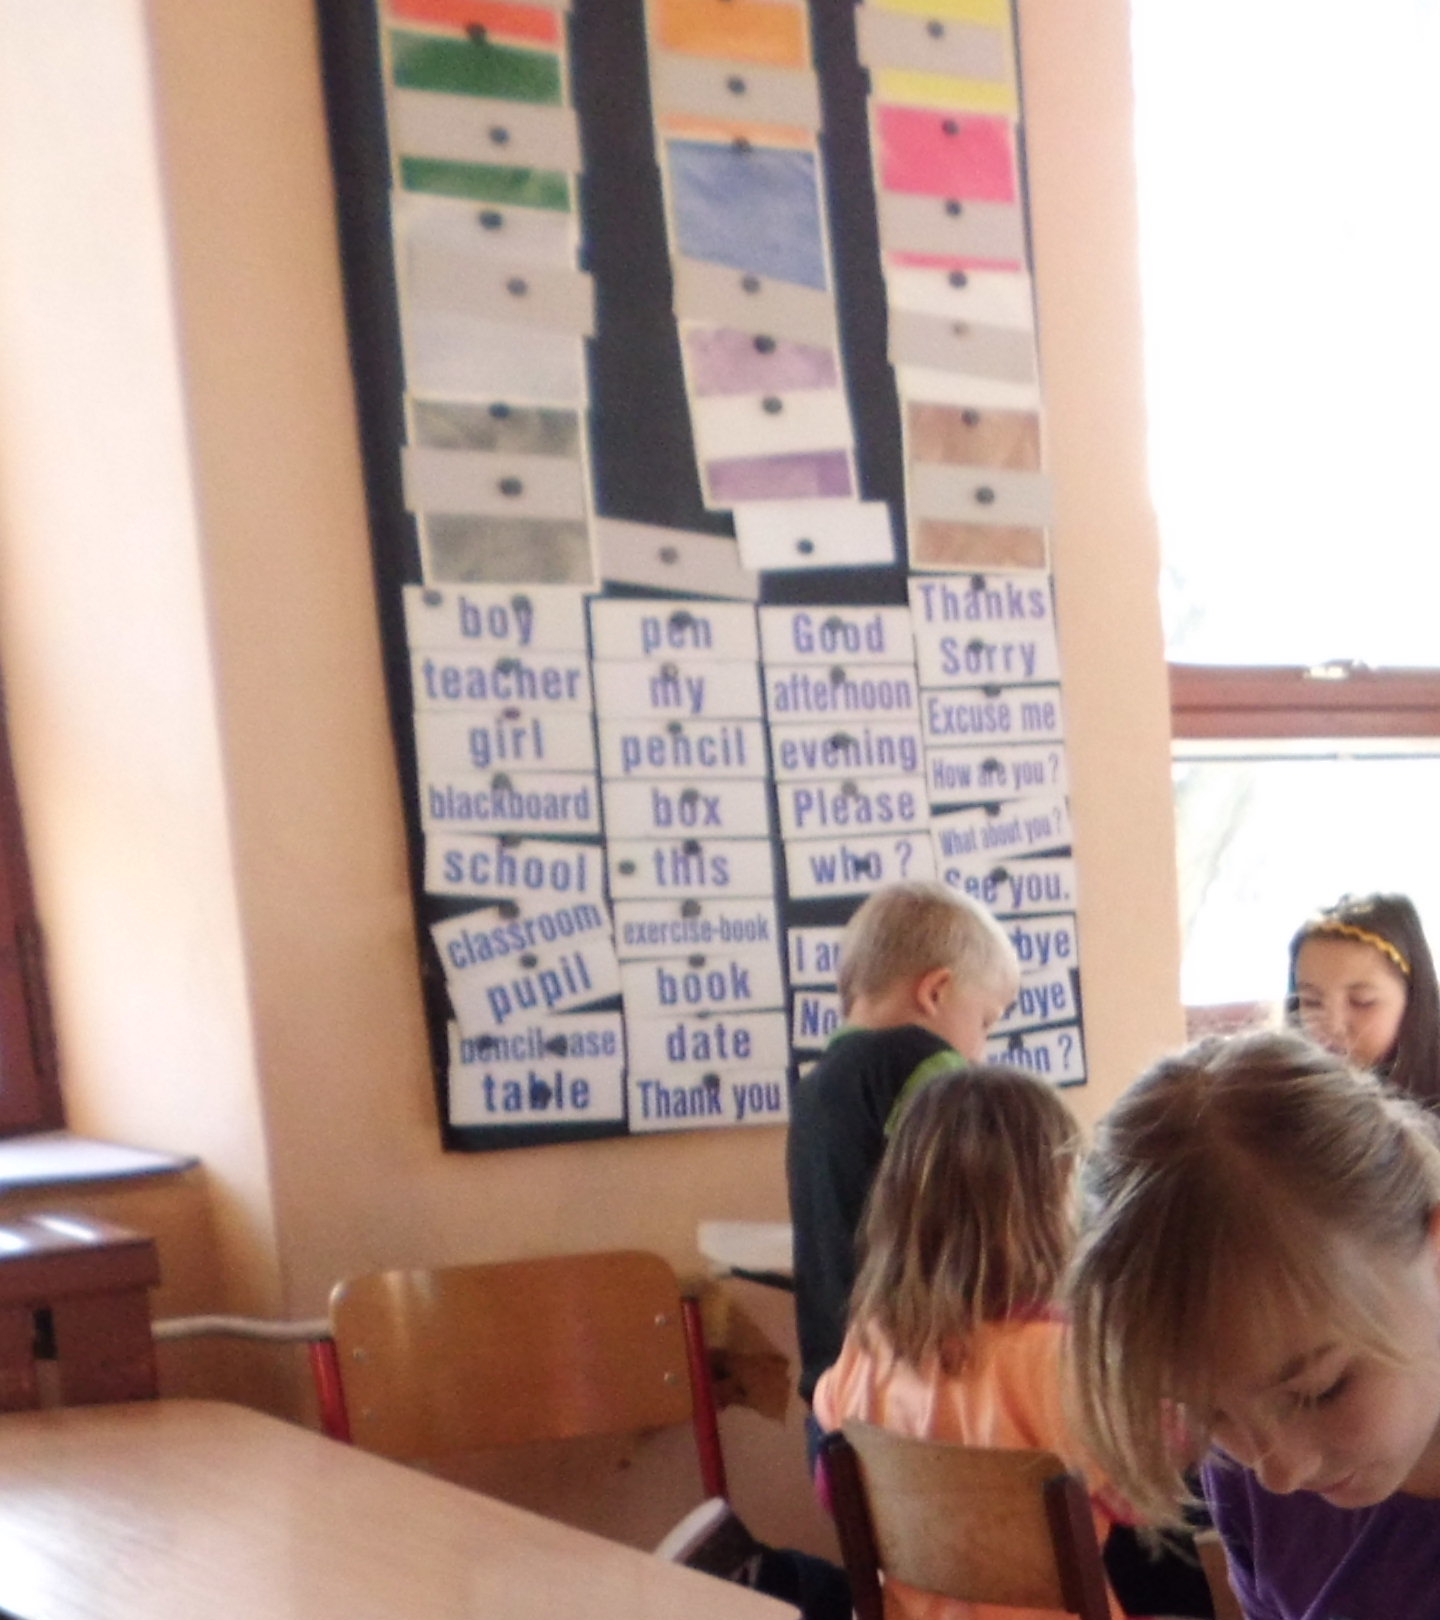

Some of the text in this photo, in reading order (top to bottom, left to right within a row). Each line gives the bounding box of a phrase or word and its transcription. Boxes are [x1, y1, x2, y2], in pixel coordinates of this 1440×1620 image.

[458, 596, 534, 646] boy
[918, 580, 1046, 623] Thanks
[641, 615, 713, 657] pen
[791, 611, 885, 654] Good
[423, 657, 581, 700] teacher
[939, 636, 1036, 678] Sorry
[650, 675, 705, 715] my
[774, 671, 914, 713] afternoon
[927, 696, 1057, 737] Excuse me
[469, 717, 544, 770] girl
[621, 726, 747, 777] pencil
[779, 728, 918, 774] evening
[932, 757, 972, 790] How
[1011, 761, 1046, 791] you
[429, 783, 591, 822] blackboard
[651, 786, 723, 828] box
[793, 787, 917, 829] Please
[939, 825, 977, 857] What
[1023, 814, 1051, 845] you
[443, 844, 588, 893] school
[653, 846, 731, 888] this
[809, 844, 884, 885] who
[447, 902, 604, 971] classroom
[623, 911, 772, 946] exercise-book
[486, 951, 594, 1025] pupil
[656, 961, 753, 1006] book
[666, 1022, 753, 1063] date
[482, 1070, 591, 1114] table
[636, 1077, 782, 1121] Thank you
